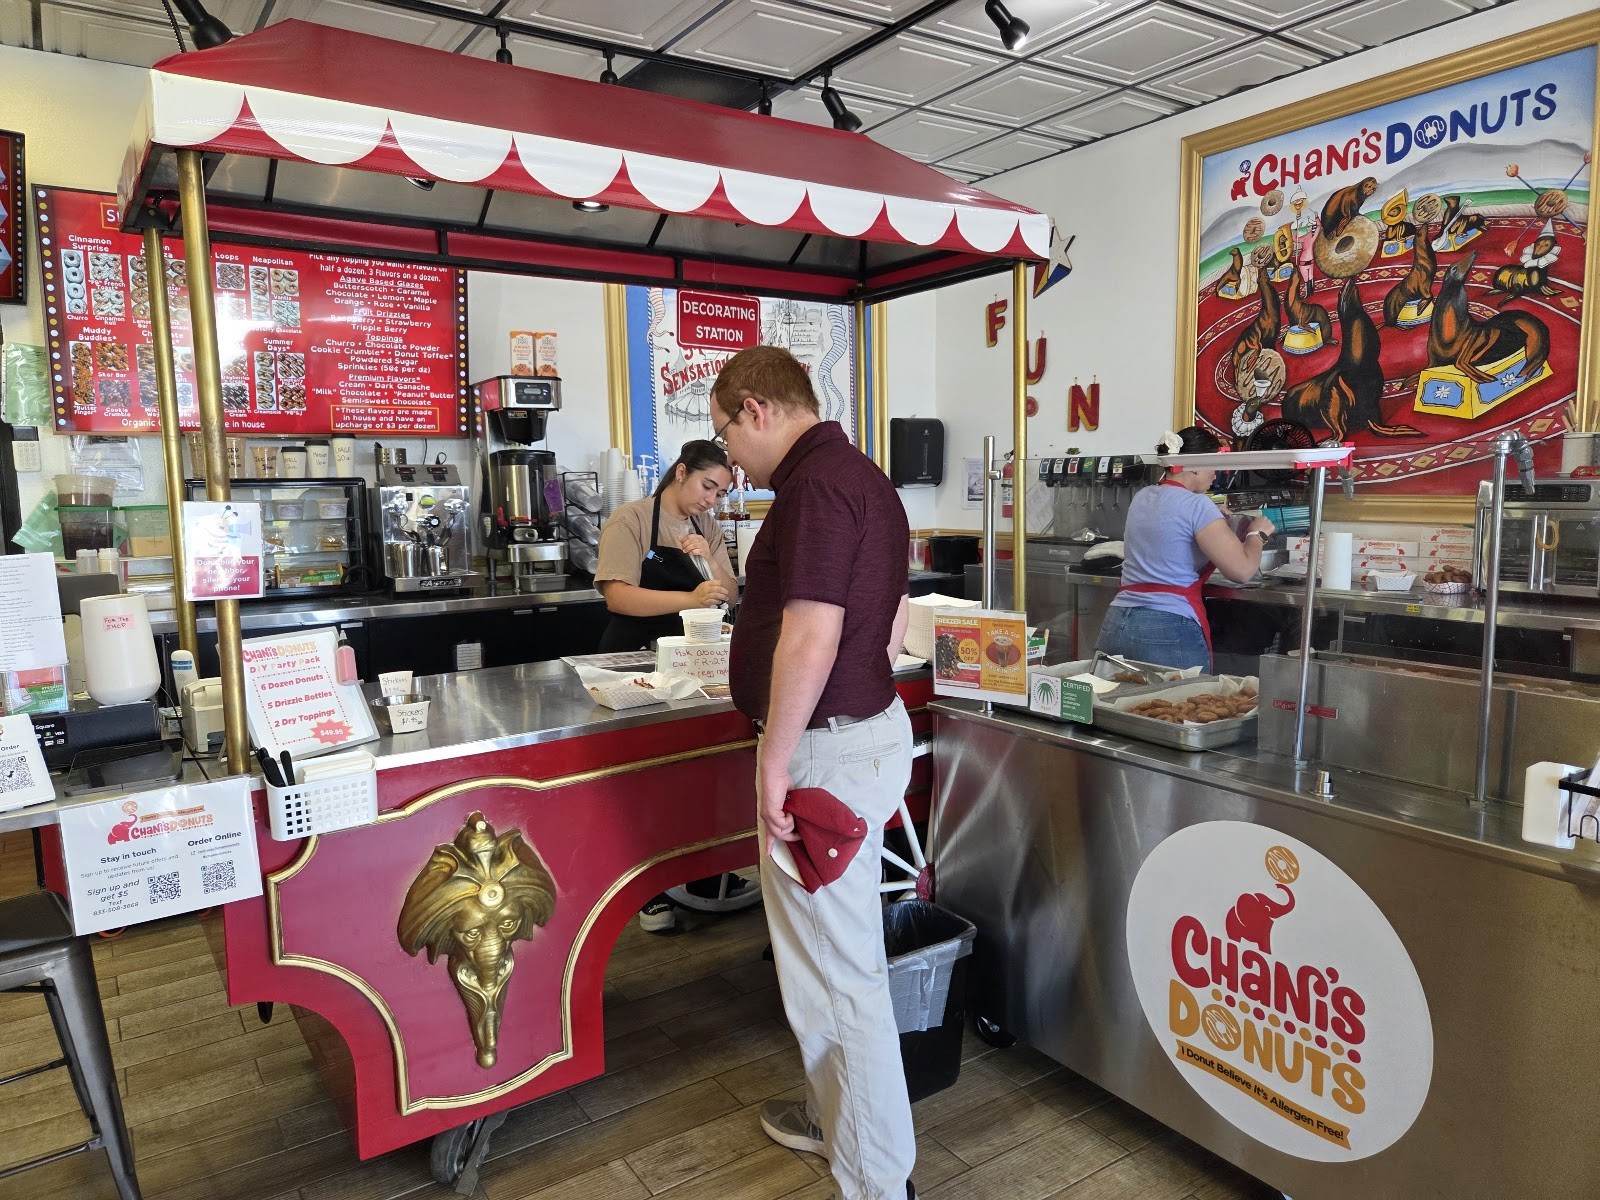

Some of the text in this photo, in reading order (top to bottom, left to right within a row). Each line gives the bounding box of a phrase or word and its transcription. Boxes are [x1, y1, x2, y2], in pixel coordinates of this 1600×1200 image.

[1385, 83, 1557, 165] DONUTS
[68, 235, 112, 245] Cinnamon
[72, 243, 109, 252] Surprise
[215, 252, 239, 260] Loops
[252, 256, 293, 266] Neapolitan
[344, 267, 367, 275] dozen.
[419, 273, 441, 282] dozen.
[340, 275, 424, 289] Agave Based Glazes
[333, 282, 430, 296] Butterscotch Caramel
[326, 289, 368, 298] Chocolate
[377, 294, 405, 302] Lemon
[334, 298, 365, 306] Orange
[403, 303, 430, 311] Vanilla
[377, 310, 411, 319] Drizzles
[682, 300, 756, 322] DECORATING
[330, 315, 431, 328] Raspberry Strawberry
[83, 326, 112, 335] Muddy
[351, 324, 407, 334] Tripple Berry
[696, 325, 743, 343] STATION
[366, 334, 403, 343] Toppings
[310, 346, 341, 354] Cookie
[365, 341, 407, 350] Chocolate
[410, 344, 440, 352] Powder
[350, 356, 392, 364] Powdered
[338, 363, 378, 371] Sprinkles
[349, 374, 384, 382] Premium
[340, 389, 381, 397] Chocolate
[341, 397, 390, 405] Semi-sweet
[121, 419, 155, 427] Organic
[336, 422, 371, 430] upcharge
[214, 585, 240, 593] phone!
[987, 629, 1003, 637] TAKE
[277, 641, 316, 656] DONUTS
[961, 647, 977, 655] 50%
[299, 655, 320, 665] Pack
[268, 679, 294, 689] Dozen
[296, 674, 324, 684] Donuts
[1062, 681, 1090, 692] CERTIFIED
[275, 697, 302, 708] Drizzle
[304, 690, 332, 701] Bottles
[282, 717, 296, 726] Dry
[299, 709, 335, 721] Toppings
[169, 813, 213, 832] DONUTS
[188, 831, 242, 847] Order Online
[132, 848, 156, 857] touch
[87, 879, 140, 896] Sign up and
[101, 890, 129, 903] get $5
[1169, 979, 1366, 1115] DONUTS
[1181, 1045, 1344, 1141] I Donut Believe It's Allergen Free!
